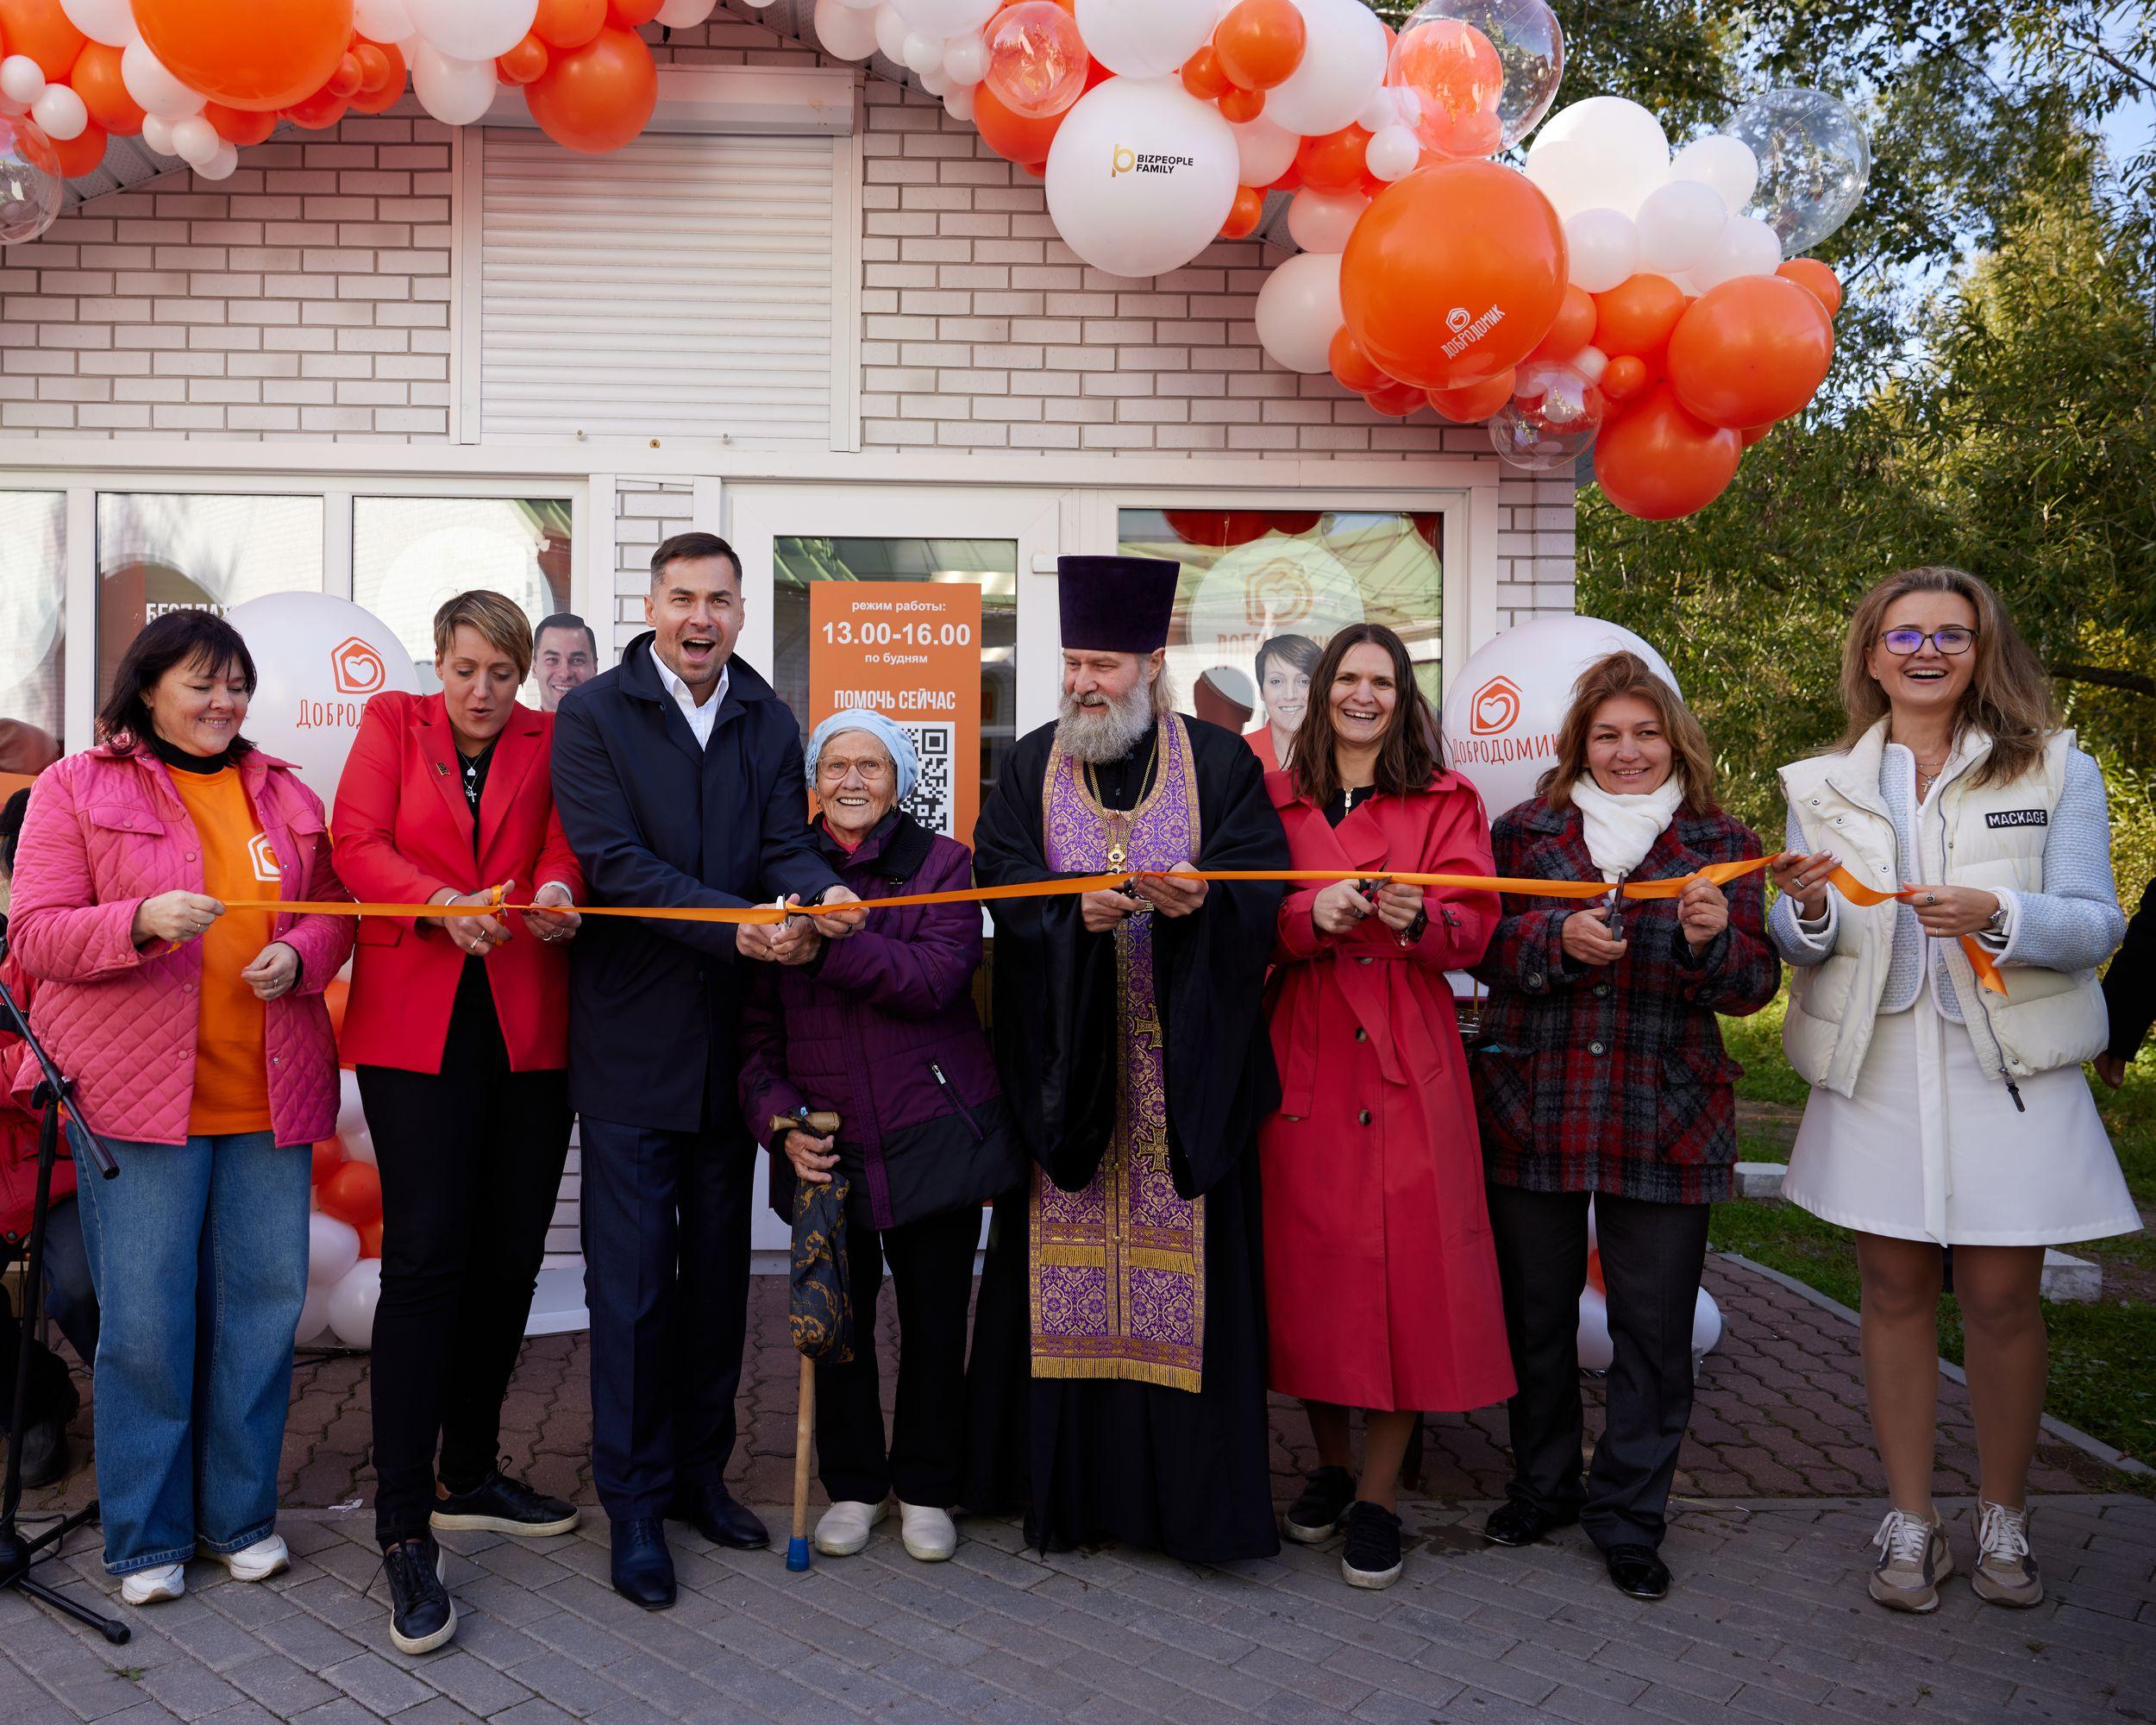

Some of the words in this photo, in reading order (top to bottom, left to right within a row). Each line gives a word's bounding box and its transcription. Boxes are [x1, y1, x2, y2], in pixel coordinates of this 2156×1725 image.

[1137, 154, 1194, 166] BIZPEOPLE
[1136, 164, 1175, 174] FAMILY
[1440, 304, 1506, 360] ДОБРОДОМИК
[852, 601, 892, 613] режим
[896, 600, 946, 613] работы:
[822, 621, 971, 646] 13.00-16.00
[865, 654, 880, 663] по
[883, 653, 928, 665] будням
[834, 690, 895, 709] ПОМОЧЬ
[899, 688, 956, 710] СЕЙЧАС
[1988, 811, 2046, 826] MACKAGE
